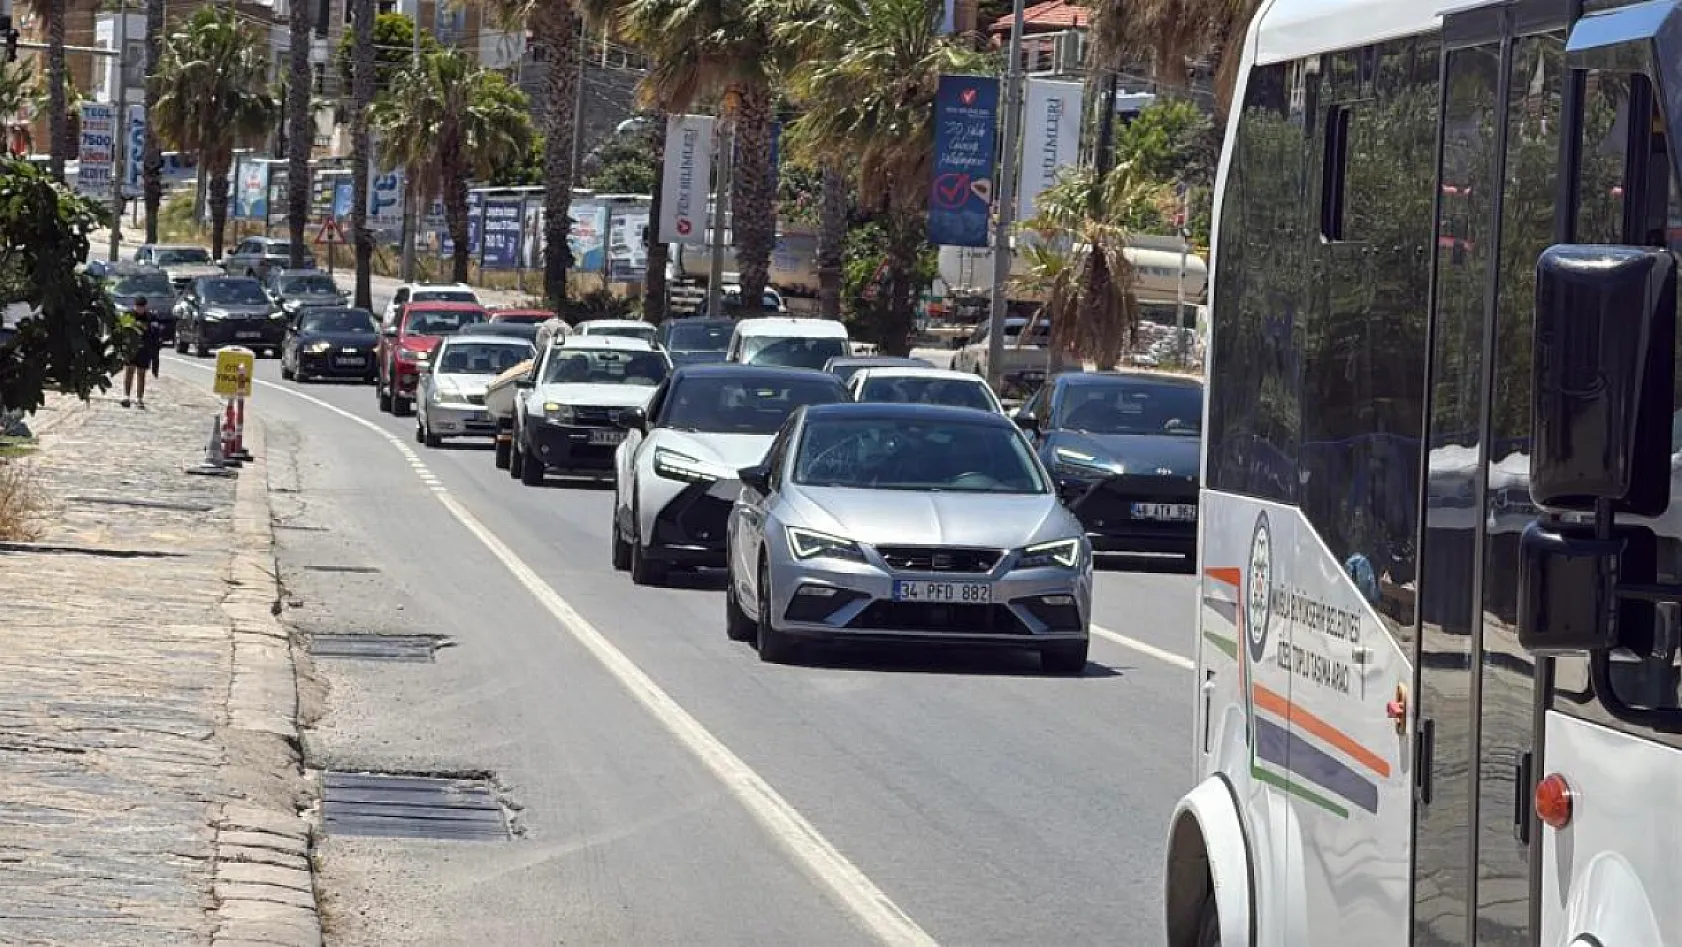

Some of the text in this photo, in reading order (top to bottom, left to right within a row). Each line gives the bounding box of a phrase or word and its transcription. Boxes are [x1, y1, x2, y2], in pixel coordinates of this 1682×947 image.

[902, 583, 988, 600] 34 PFD 882
